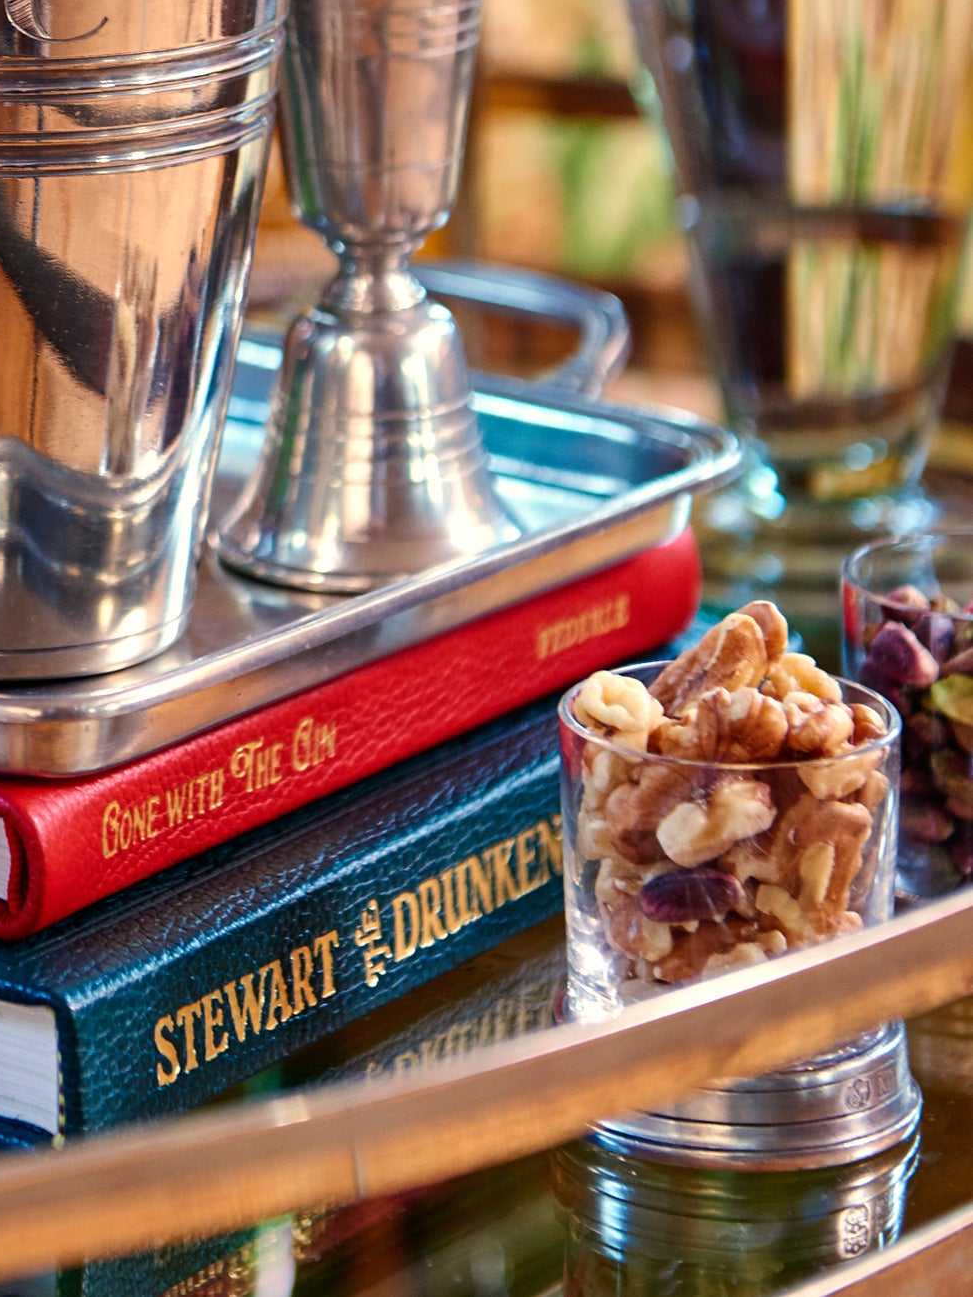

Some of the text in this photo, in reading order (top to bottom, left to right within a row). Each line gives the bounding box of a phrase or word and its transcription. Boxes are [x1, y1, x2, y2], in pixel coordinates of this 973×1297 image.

[101, 799, 160, 859] GONE
[165, 767, 225, 828] WITH
[230, 736, 284, 793] THE
[154, 929, 340, 1087] STEWART
[392, 813, 565, 963] DRUNKEN
